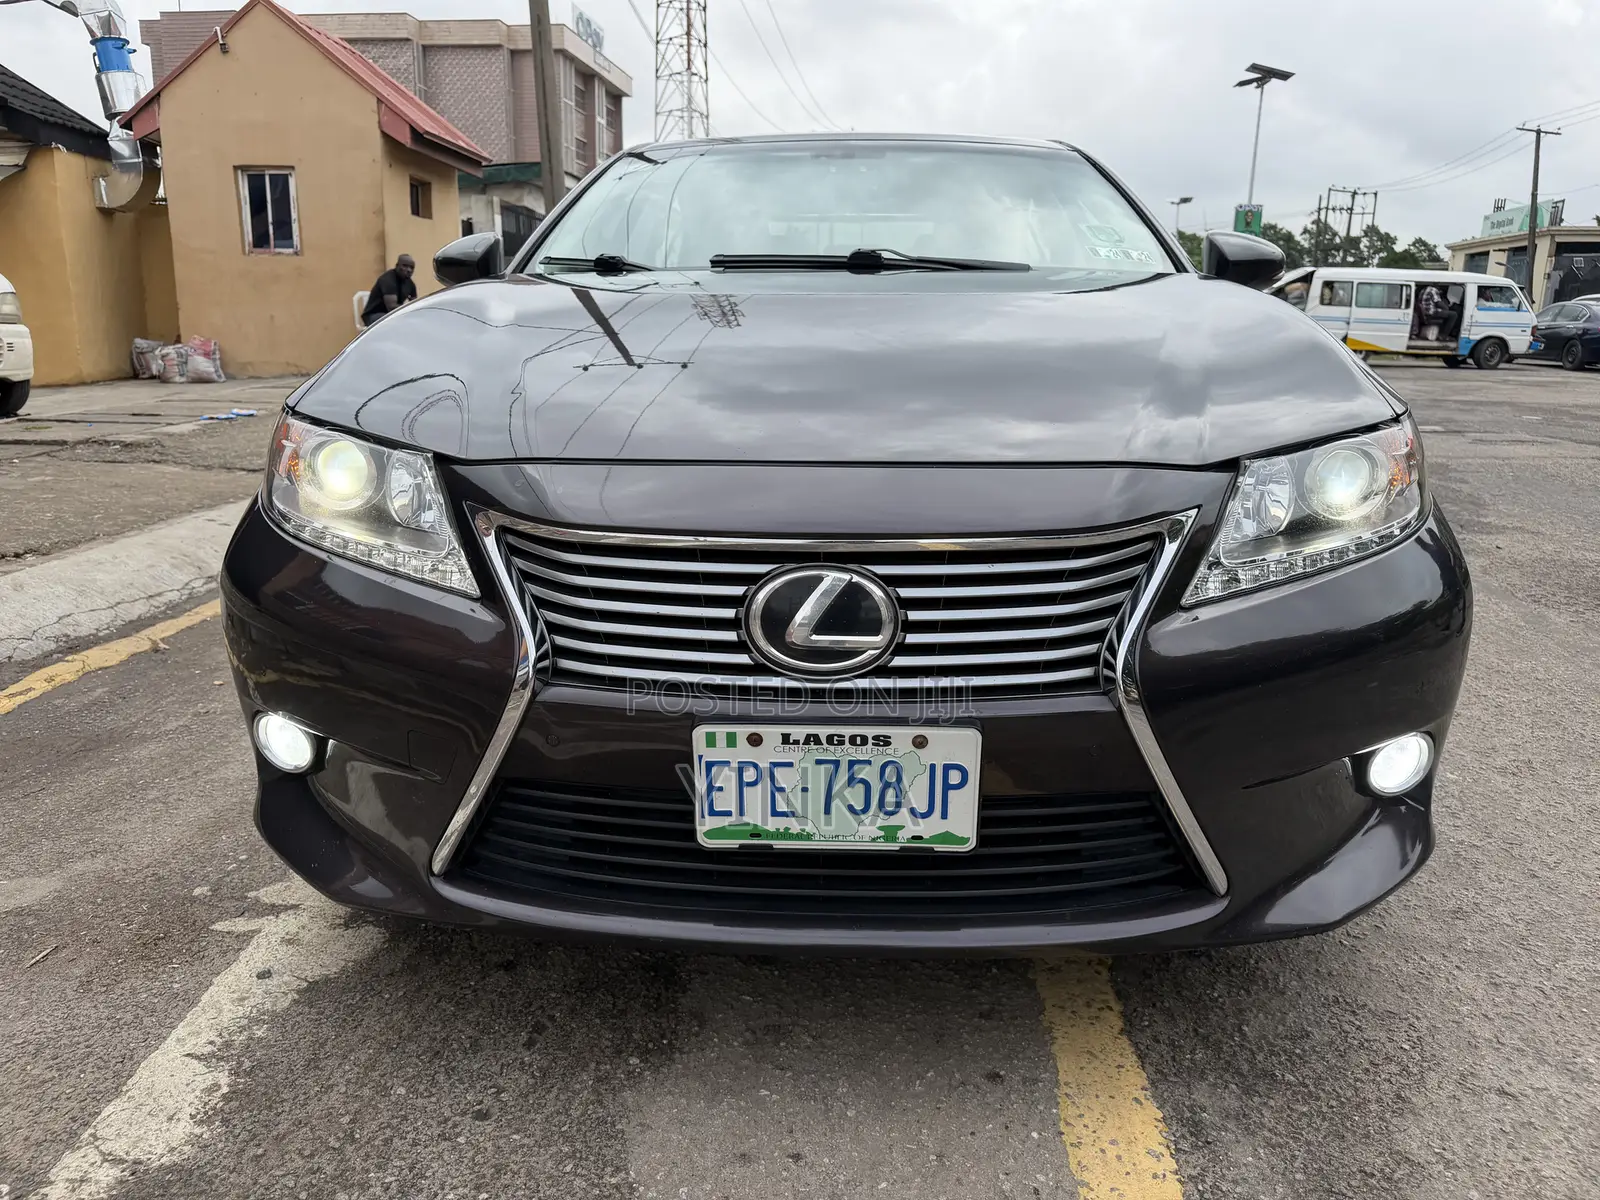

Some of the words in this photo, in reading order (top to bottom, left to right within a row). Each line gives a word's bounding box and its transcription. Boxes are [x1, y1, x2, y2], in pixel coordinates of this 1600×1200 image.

[781, 733, 892, 747] LAGOS
[773, 745, 812, 754] CENTRE
[815, 746, 833, 754] OF
[834, 746, 900, 755] EXCELLENCE
